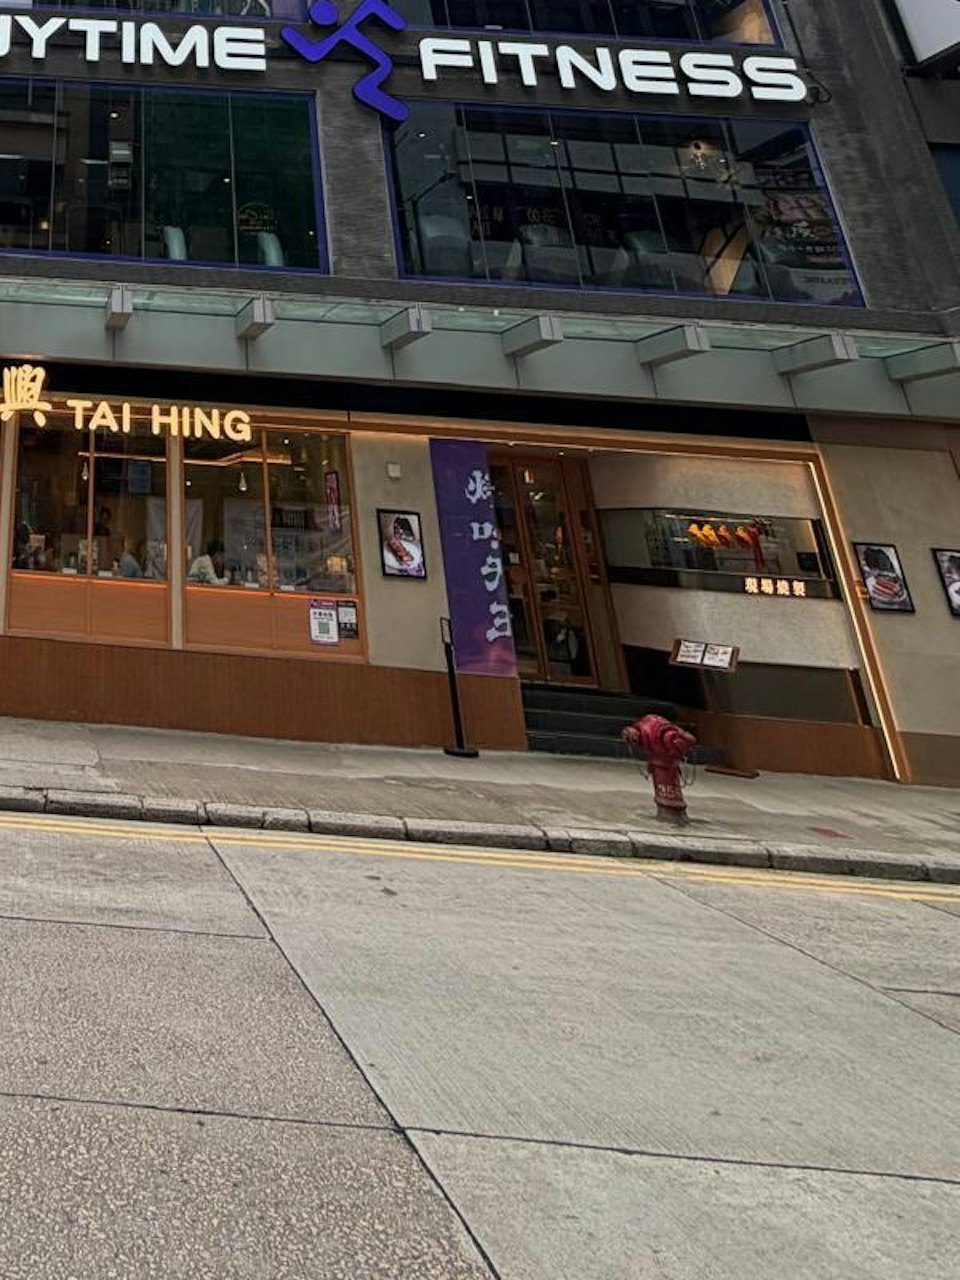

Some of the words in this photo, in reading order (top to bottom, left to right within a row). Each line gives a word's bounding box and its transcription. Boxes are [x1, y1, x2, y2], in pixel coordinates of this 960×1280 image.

[419, 37, 808, 101] FITNESS
[66, 398, 130, 433] TAI
[151, 403, 252, 442] HING
